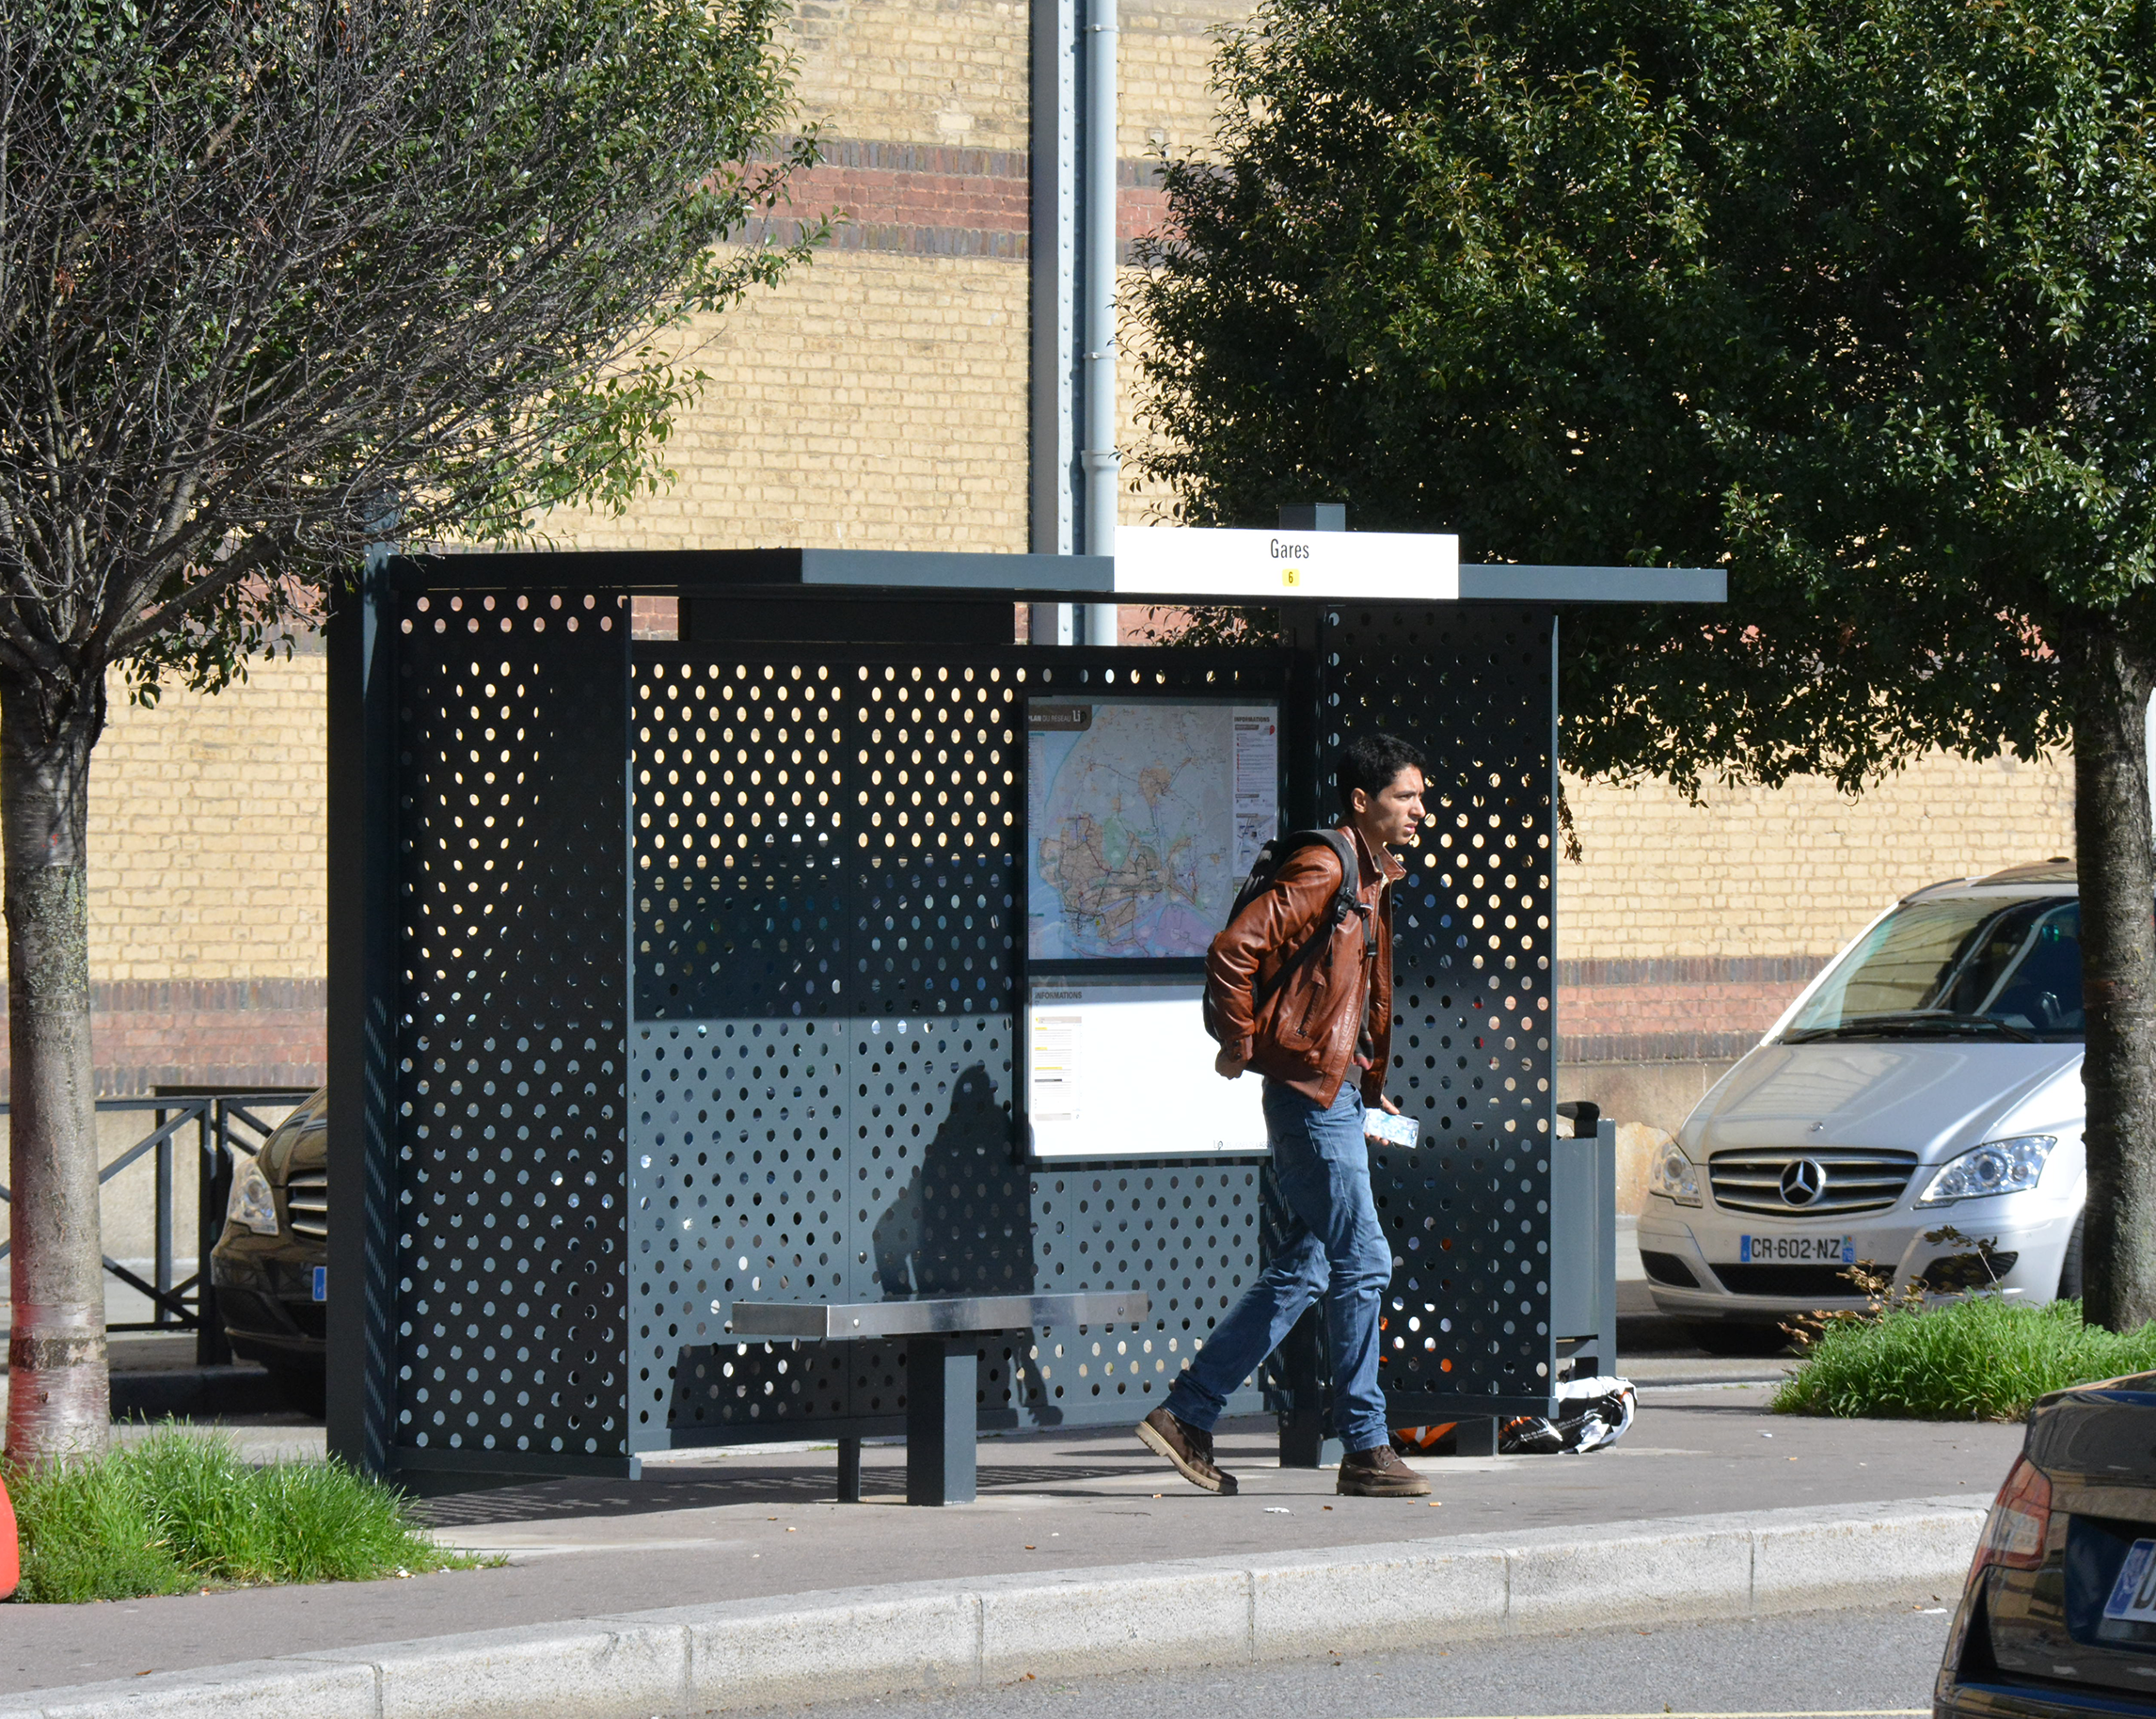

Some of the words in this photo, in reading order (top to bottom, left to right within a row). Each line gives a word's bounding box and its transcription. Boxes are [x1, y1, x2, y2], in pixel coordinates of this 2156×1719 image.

[1270, 538, 1309, 560] Gares
[1288, 570, 1293, 583] 6
[1751, 1238, 1840, 1259] CR-602-NZ
